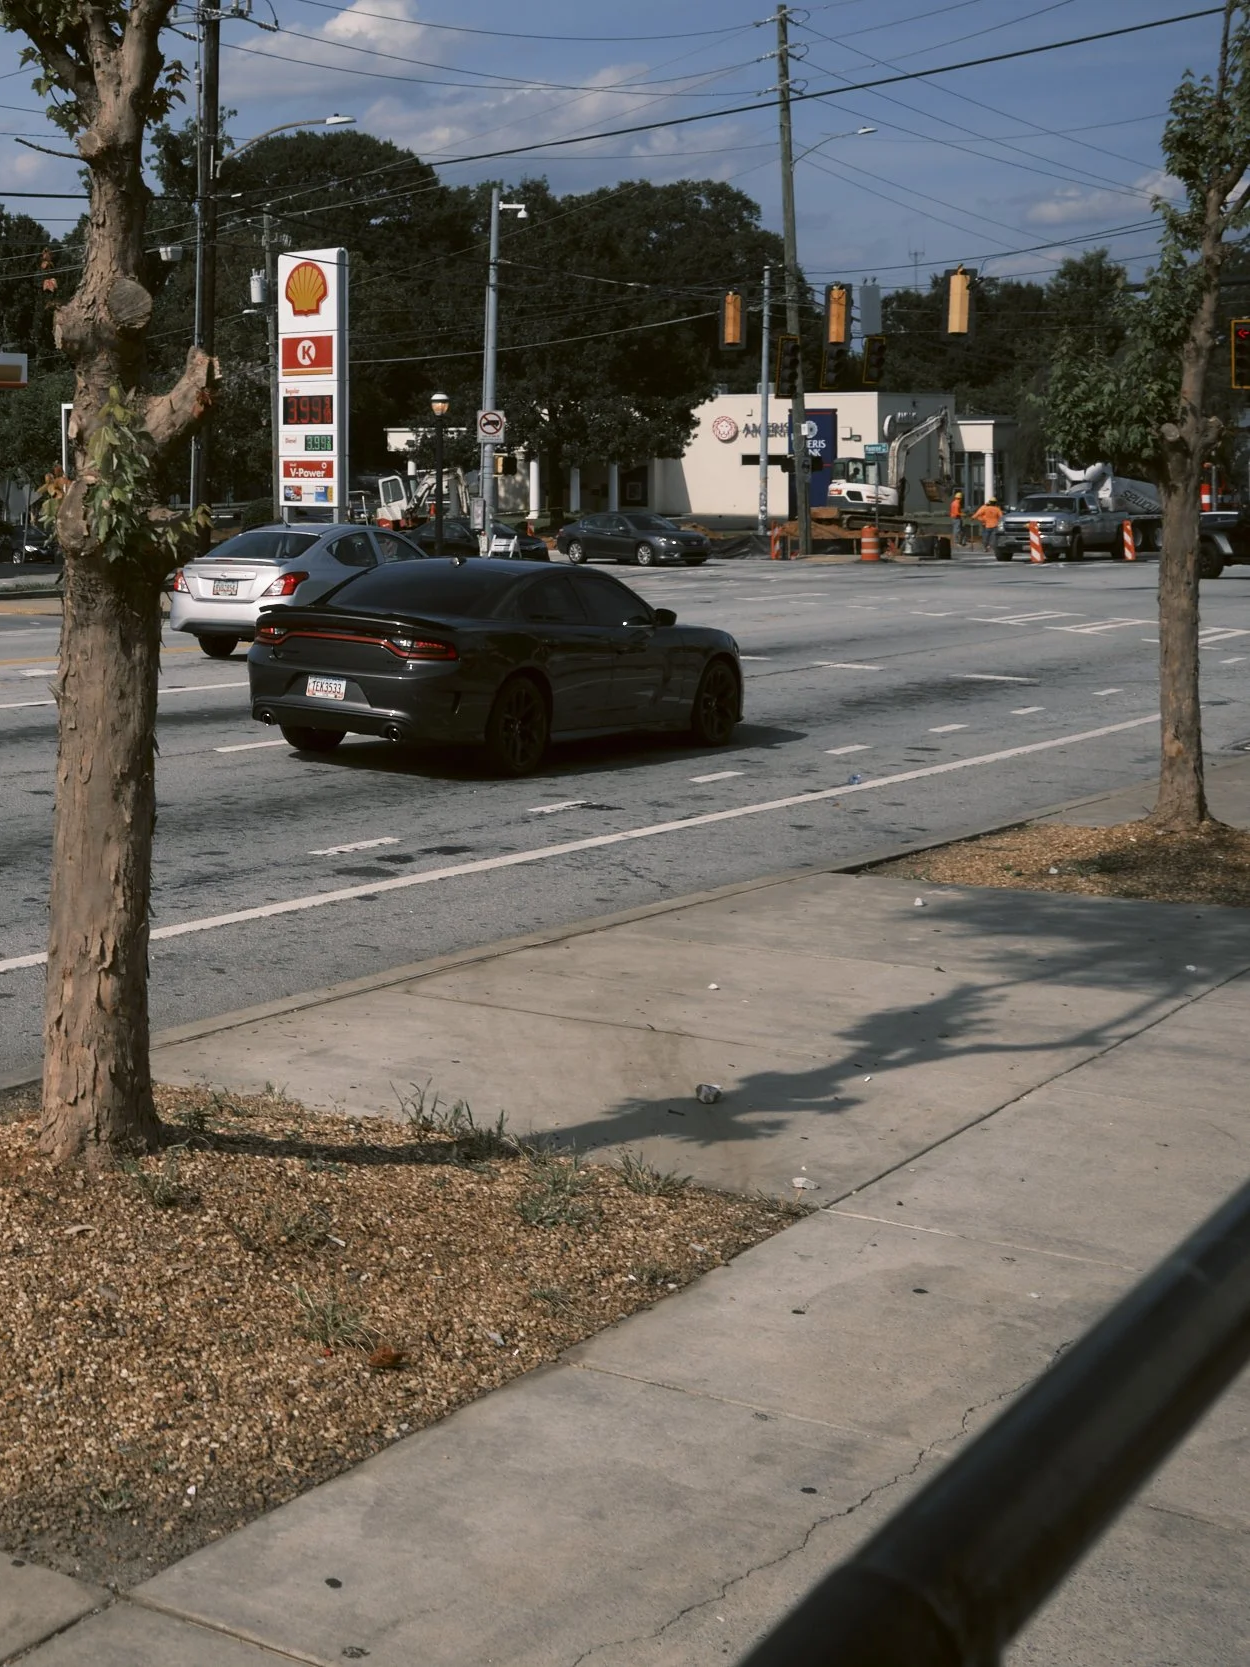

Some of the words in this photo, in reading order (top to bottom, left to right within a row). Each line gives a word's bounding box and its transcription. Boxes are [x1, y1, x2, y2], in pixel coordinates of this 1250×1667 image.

[302, 345, 314, 363] K
[807, 440, 826, 449] ERIS
[290, 468, 326, 478] V-Power
